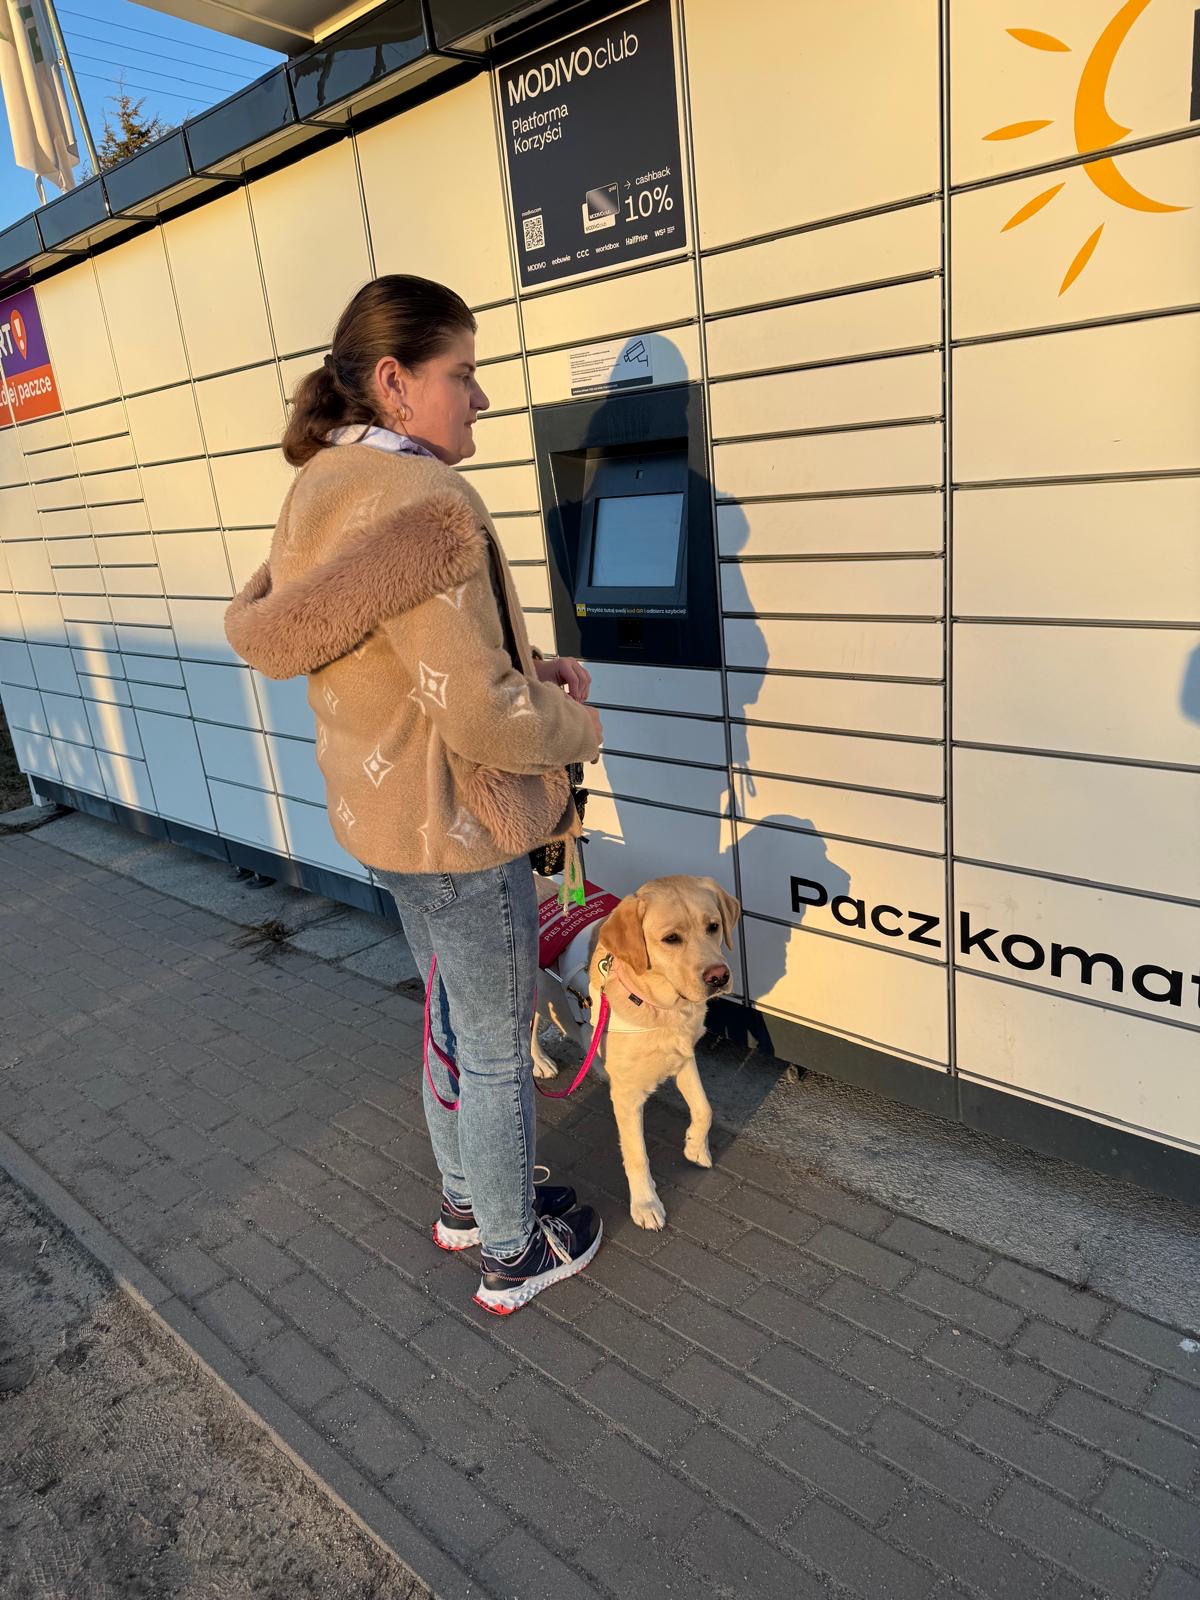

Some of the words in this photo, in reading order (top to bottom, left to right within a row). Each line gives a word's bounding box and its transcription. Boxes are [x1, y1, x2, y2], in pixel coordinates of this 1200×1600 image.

[511, 104, 569, 137] Platforma
[513, 122, 562, 155] Korzyści
[635, 165, 672, 186] cashback
[624, 184, 674, 223] 10%
[527, 261, 547, 273] MODIVO
[576, 248, 590, 259] CCC
[625, 233, 649, 246] HalfPrice
[18, 376, 52, 406] paczce
[561, 917, 585, 937] GUIDE
